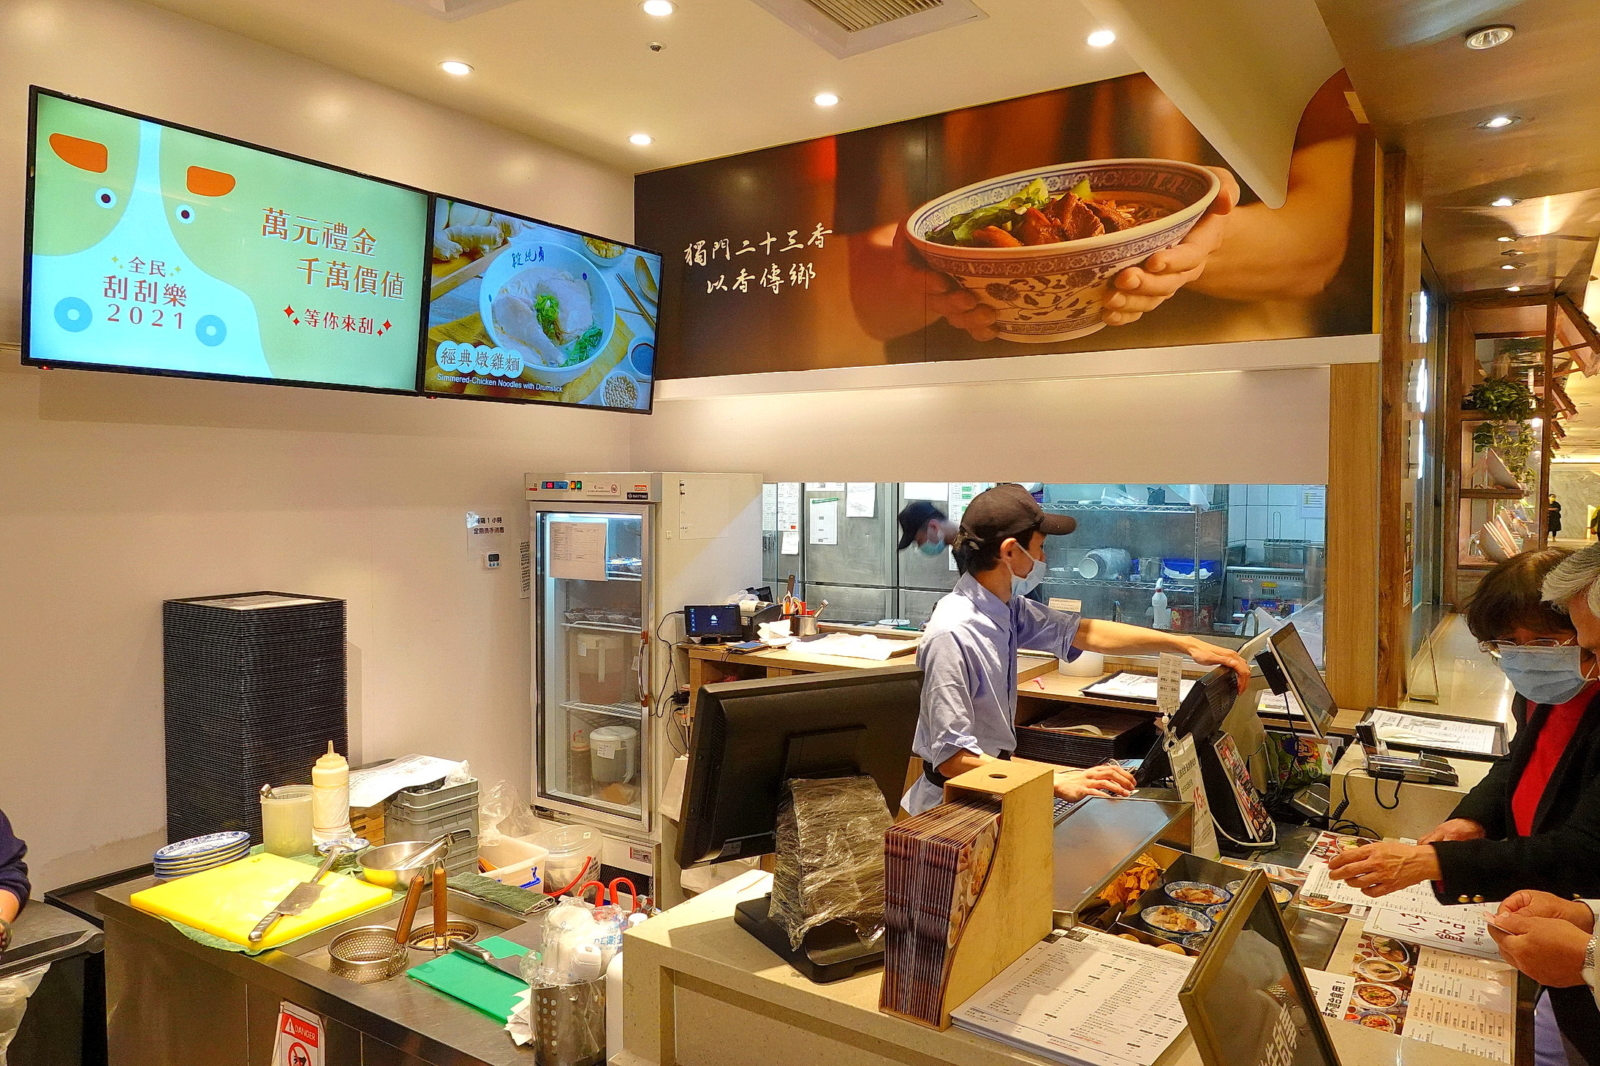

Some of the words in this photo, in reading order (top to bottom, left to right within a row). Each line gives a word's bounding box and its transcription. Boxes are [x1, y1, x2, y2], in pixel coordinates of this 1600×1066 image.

[261, 207, 377, 257] 萬元禮金
[683, 222, 833, 266] 獨門二十三香
[128, 256, 166, 278] 全民
[296, 257, 405, 300] 千萬價值
[103, 275, 187, 307] 刮刮樂
[107, 303, 182, 329] 2021
[304, 308, 374, 335] 等你來刮
[441, 347, 521, 372] 經典燉雞麵
[498, 379, 522, 389] Noodles
[523, 381, 535, 390] with
